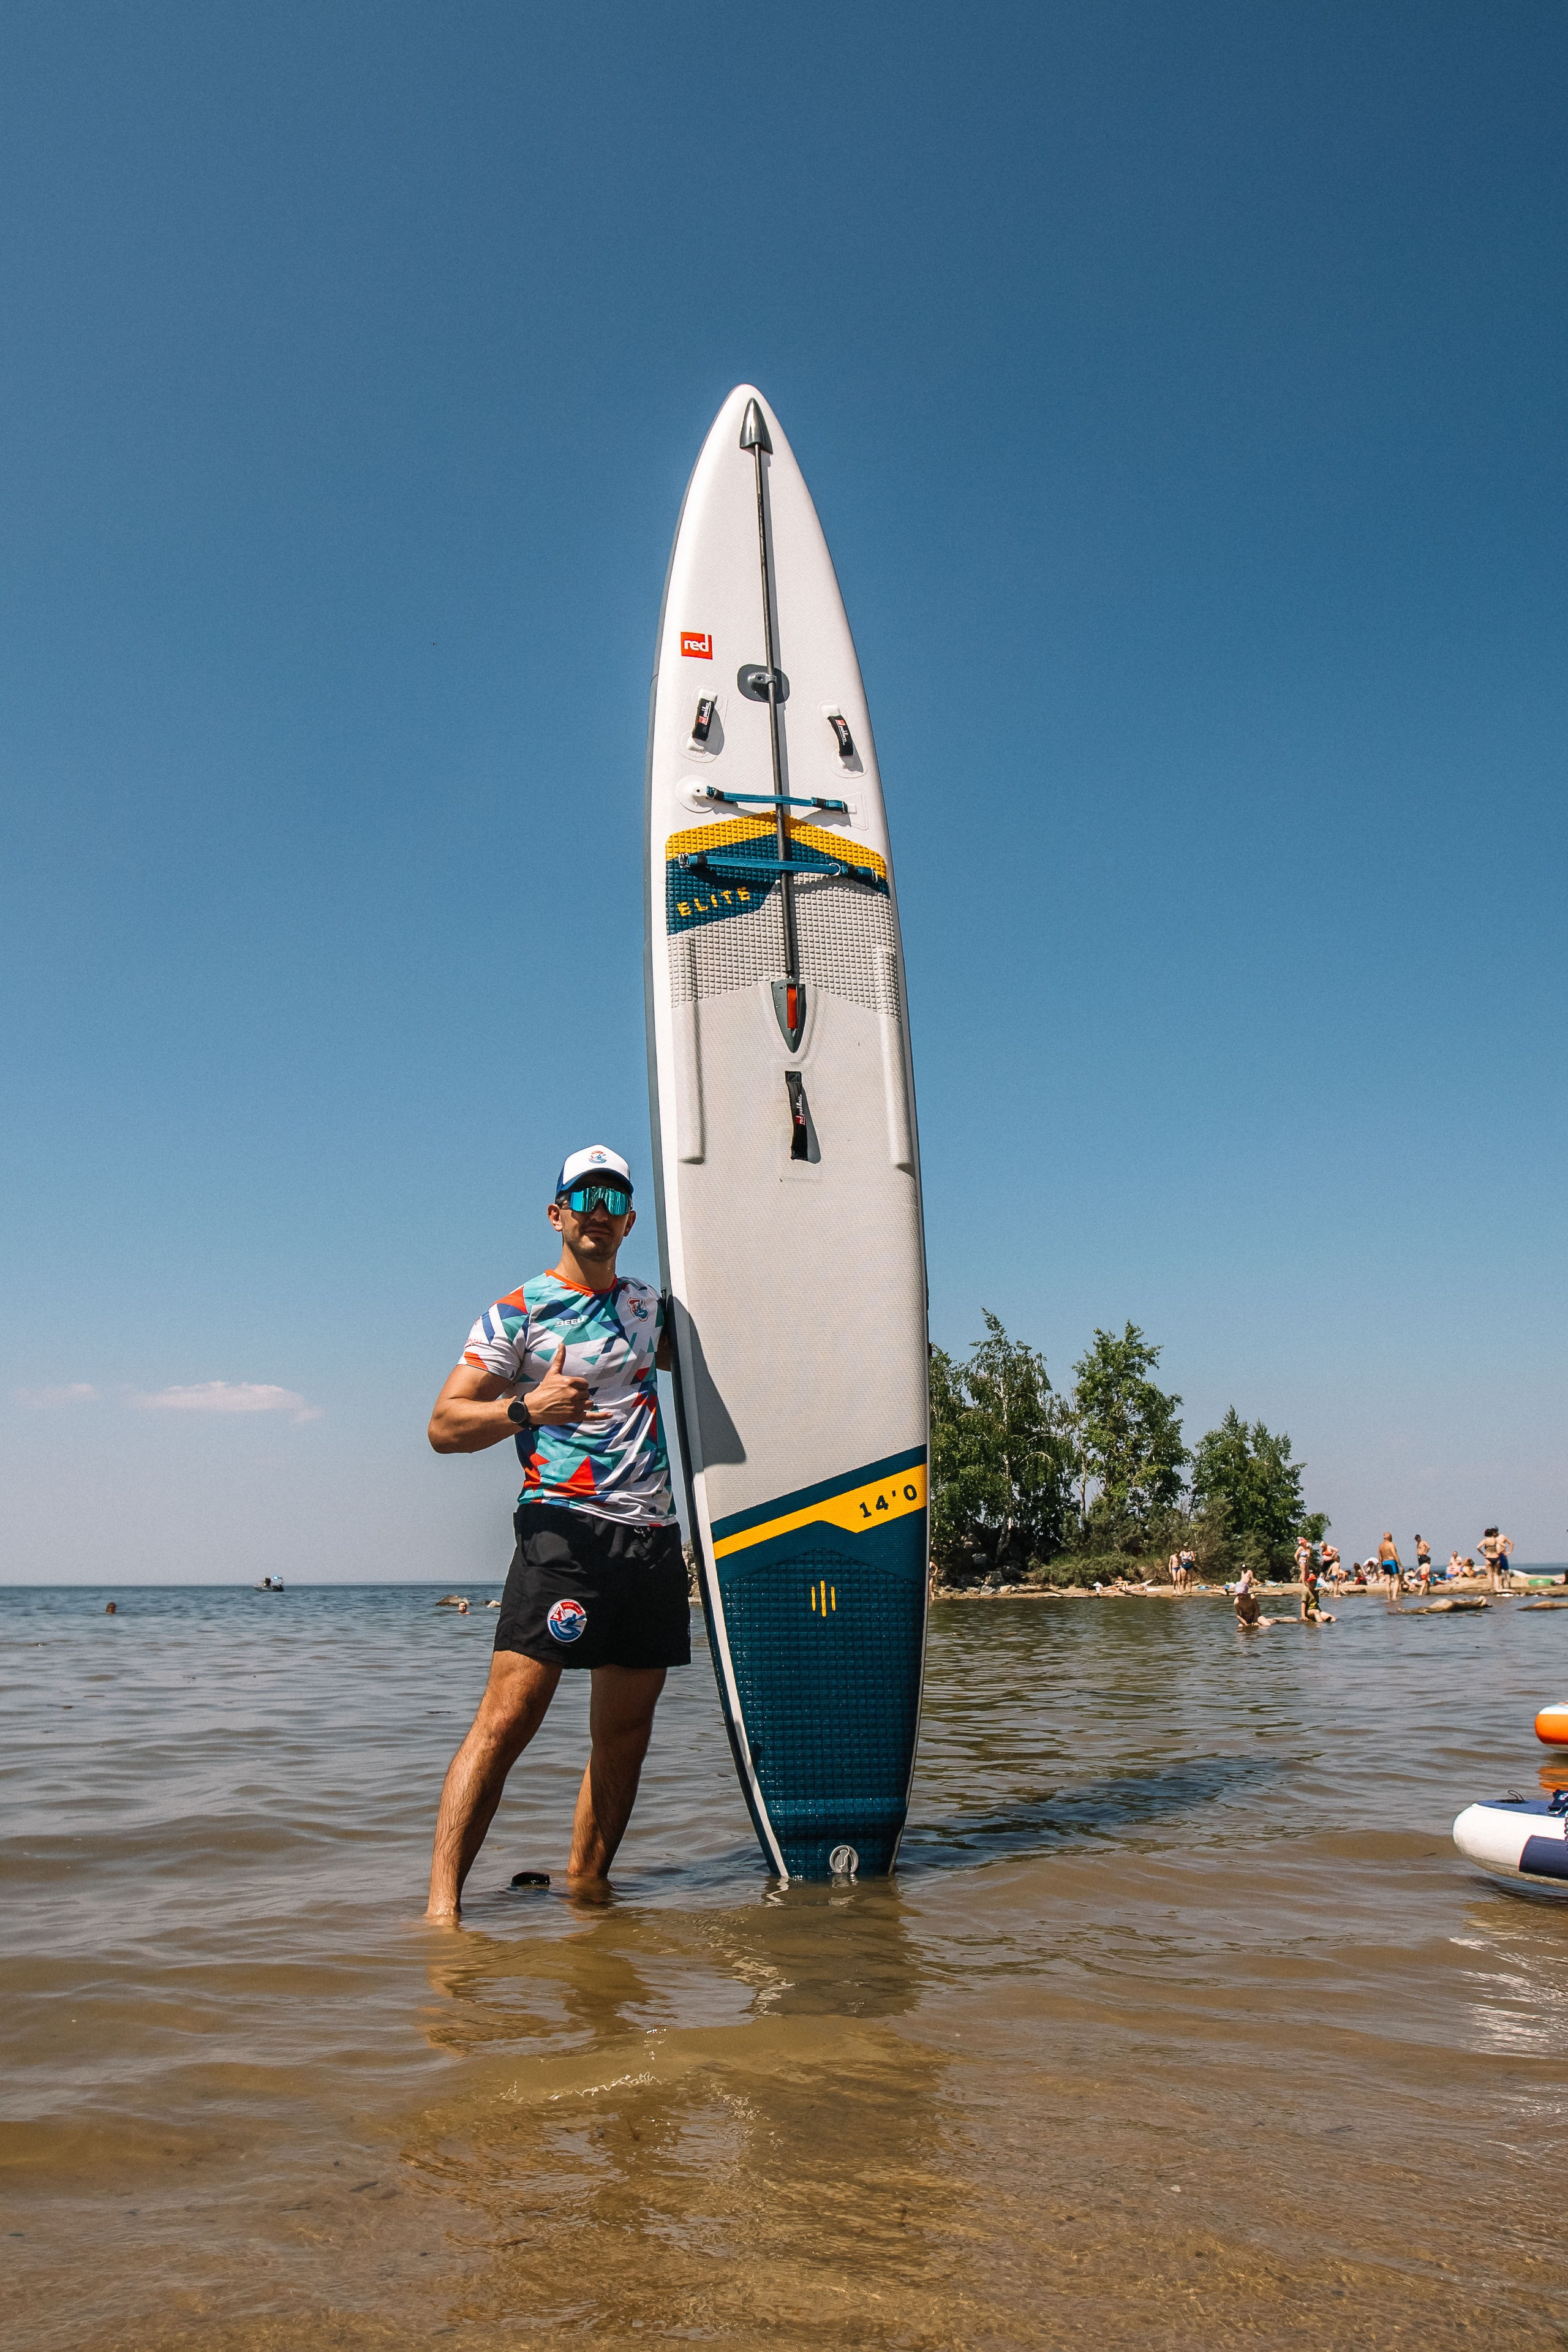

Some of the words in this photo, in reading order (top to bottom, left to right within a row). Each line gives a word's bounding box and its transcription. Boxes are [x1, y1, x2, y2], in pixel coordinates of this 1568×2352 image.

[684, 634, 709, 652] red
[677, 887, 750, 916] ELITE
[859, 1484, 918, 1518] 14'0
